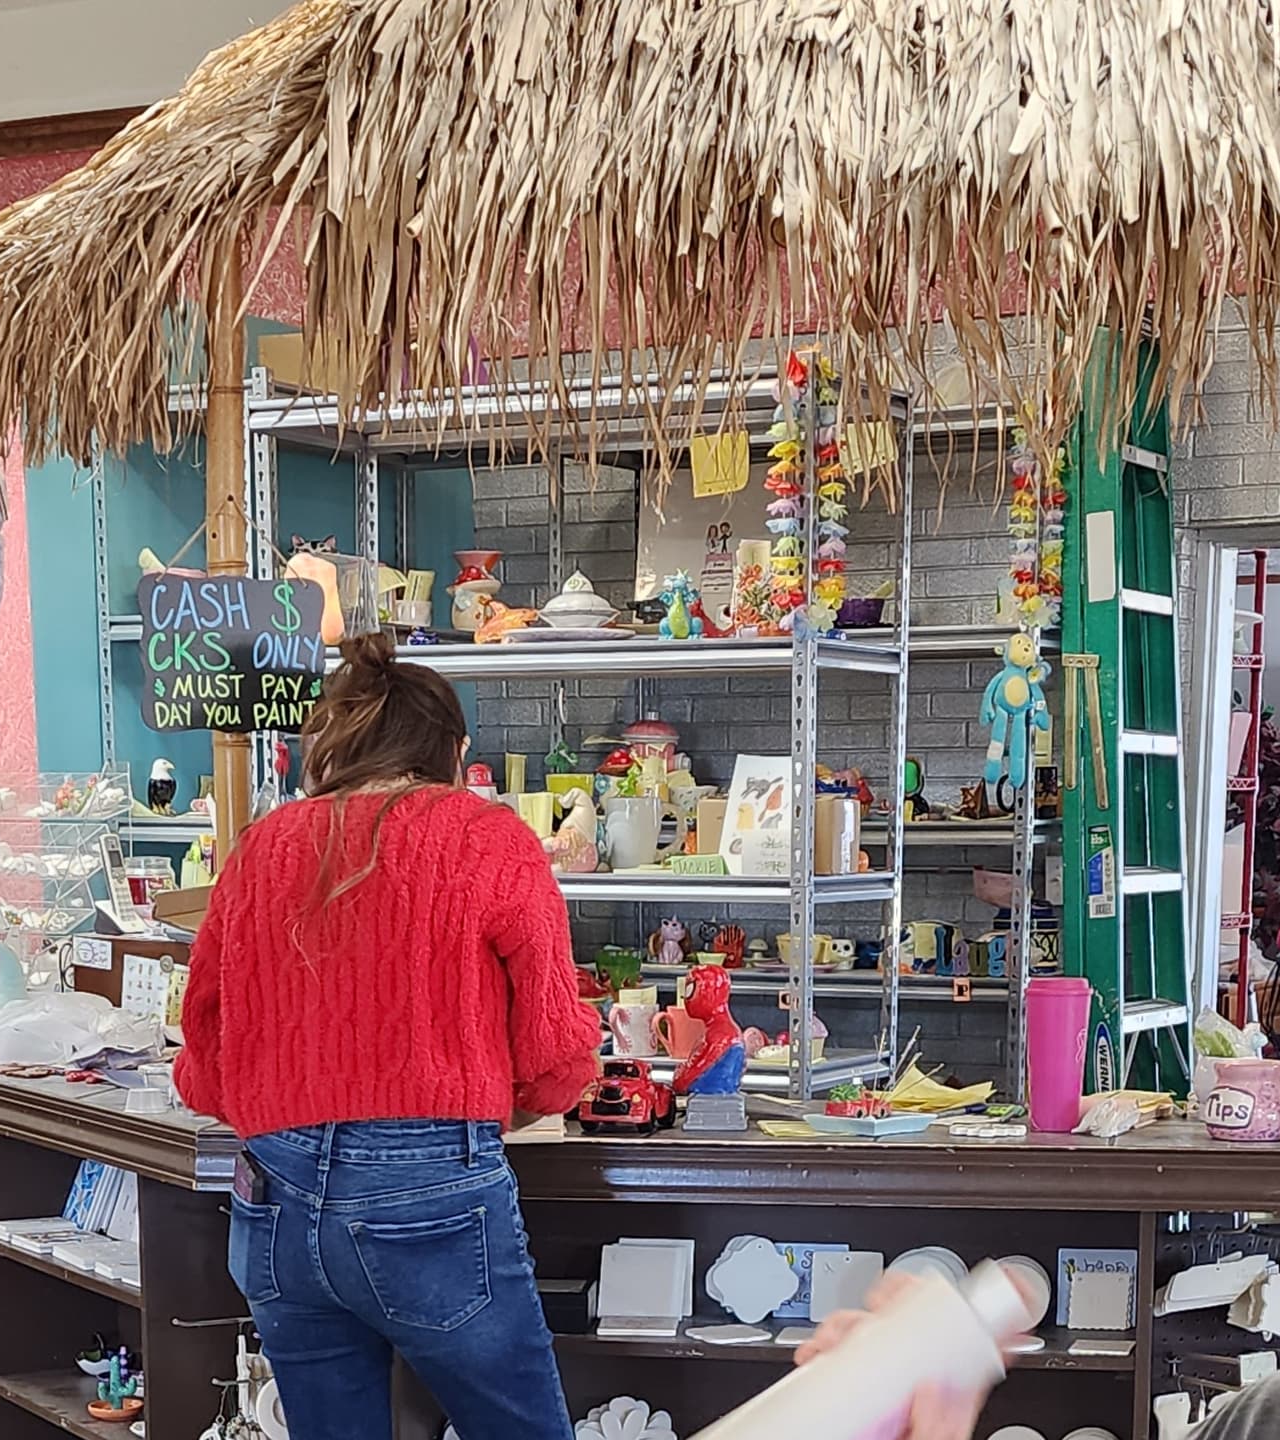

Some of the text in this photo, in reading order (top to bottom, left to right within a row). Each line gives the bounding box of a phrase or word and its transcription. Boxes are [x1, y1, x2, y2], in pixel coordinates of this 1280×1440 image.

[151, 580, 301, 636] CASH $
[148, 631, 321, 673] CKS. ONLY
[172, 674, 303, 700] MUST PAY
[154, 700, 316, 729] DAY YOU PAINT
[935, 925, 1011, 977] Laug
[1206, 1093, 1250, 1122] Tips
